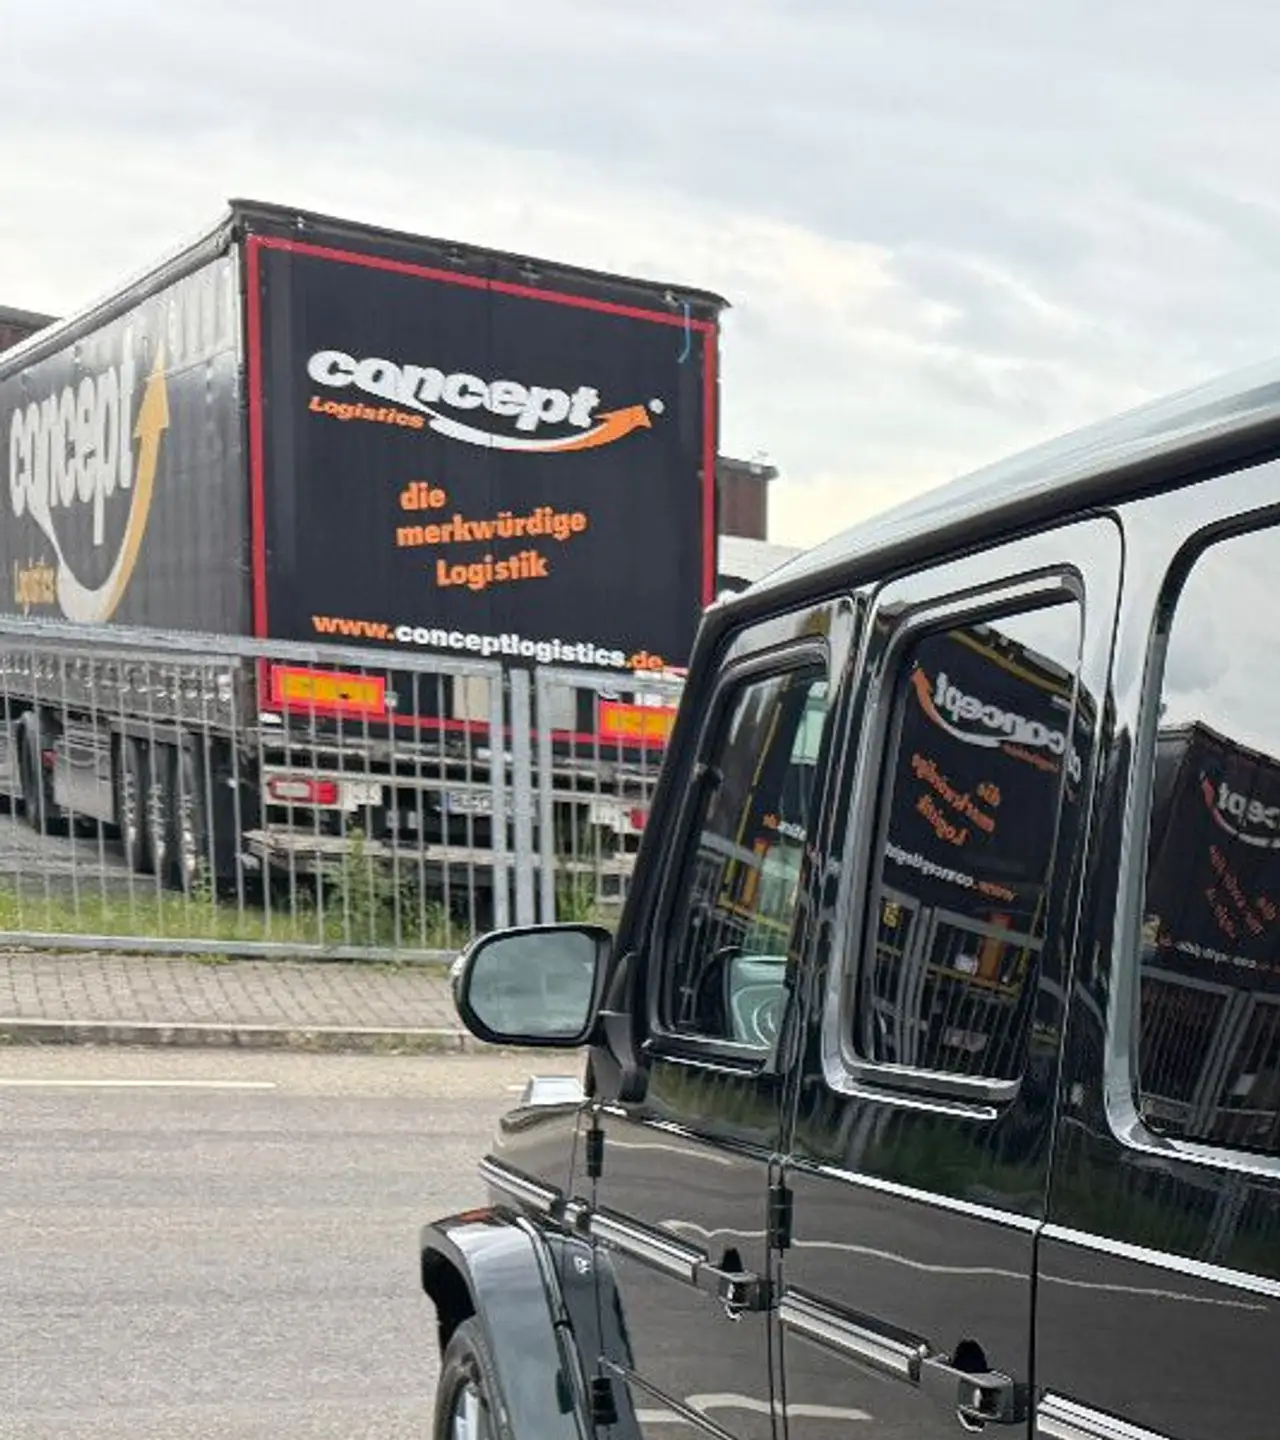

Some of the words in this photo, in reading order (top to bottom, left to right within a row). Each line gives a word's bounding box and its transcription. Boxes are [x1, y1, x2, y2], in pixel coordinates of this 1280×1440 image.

[307, 350, 600, 432] concept
[308, 395, 426, 430] Logistics
[9, 321, 135, 546] concept
[400, 481, 447, 511] die
[396, 505, 588, 548] merkwürdige
[436, 549, 550, 590] Logistik
[312, 613, 666, 672] www.conceptlogistics.de
